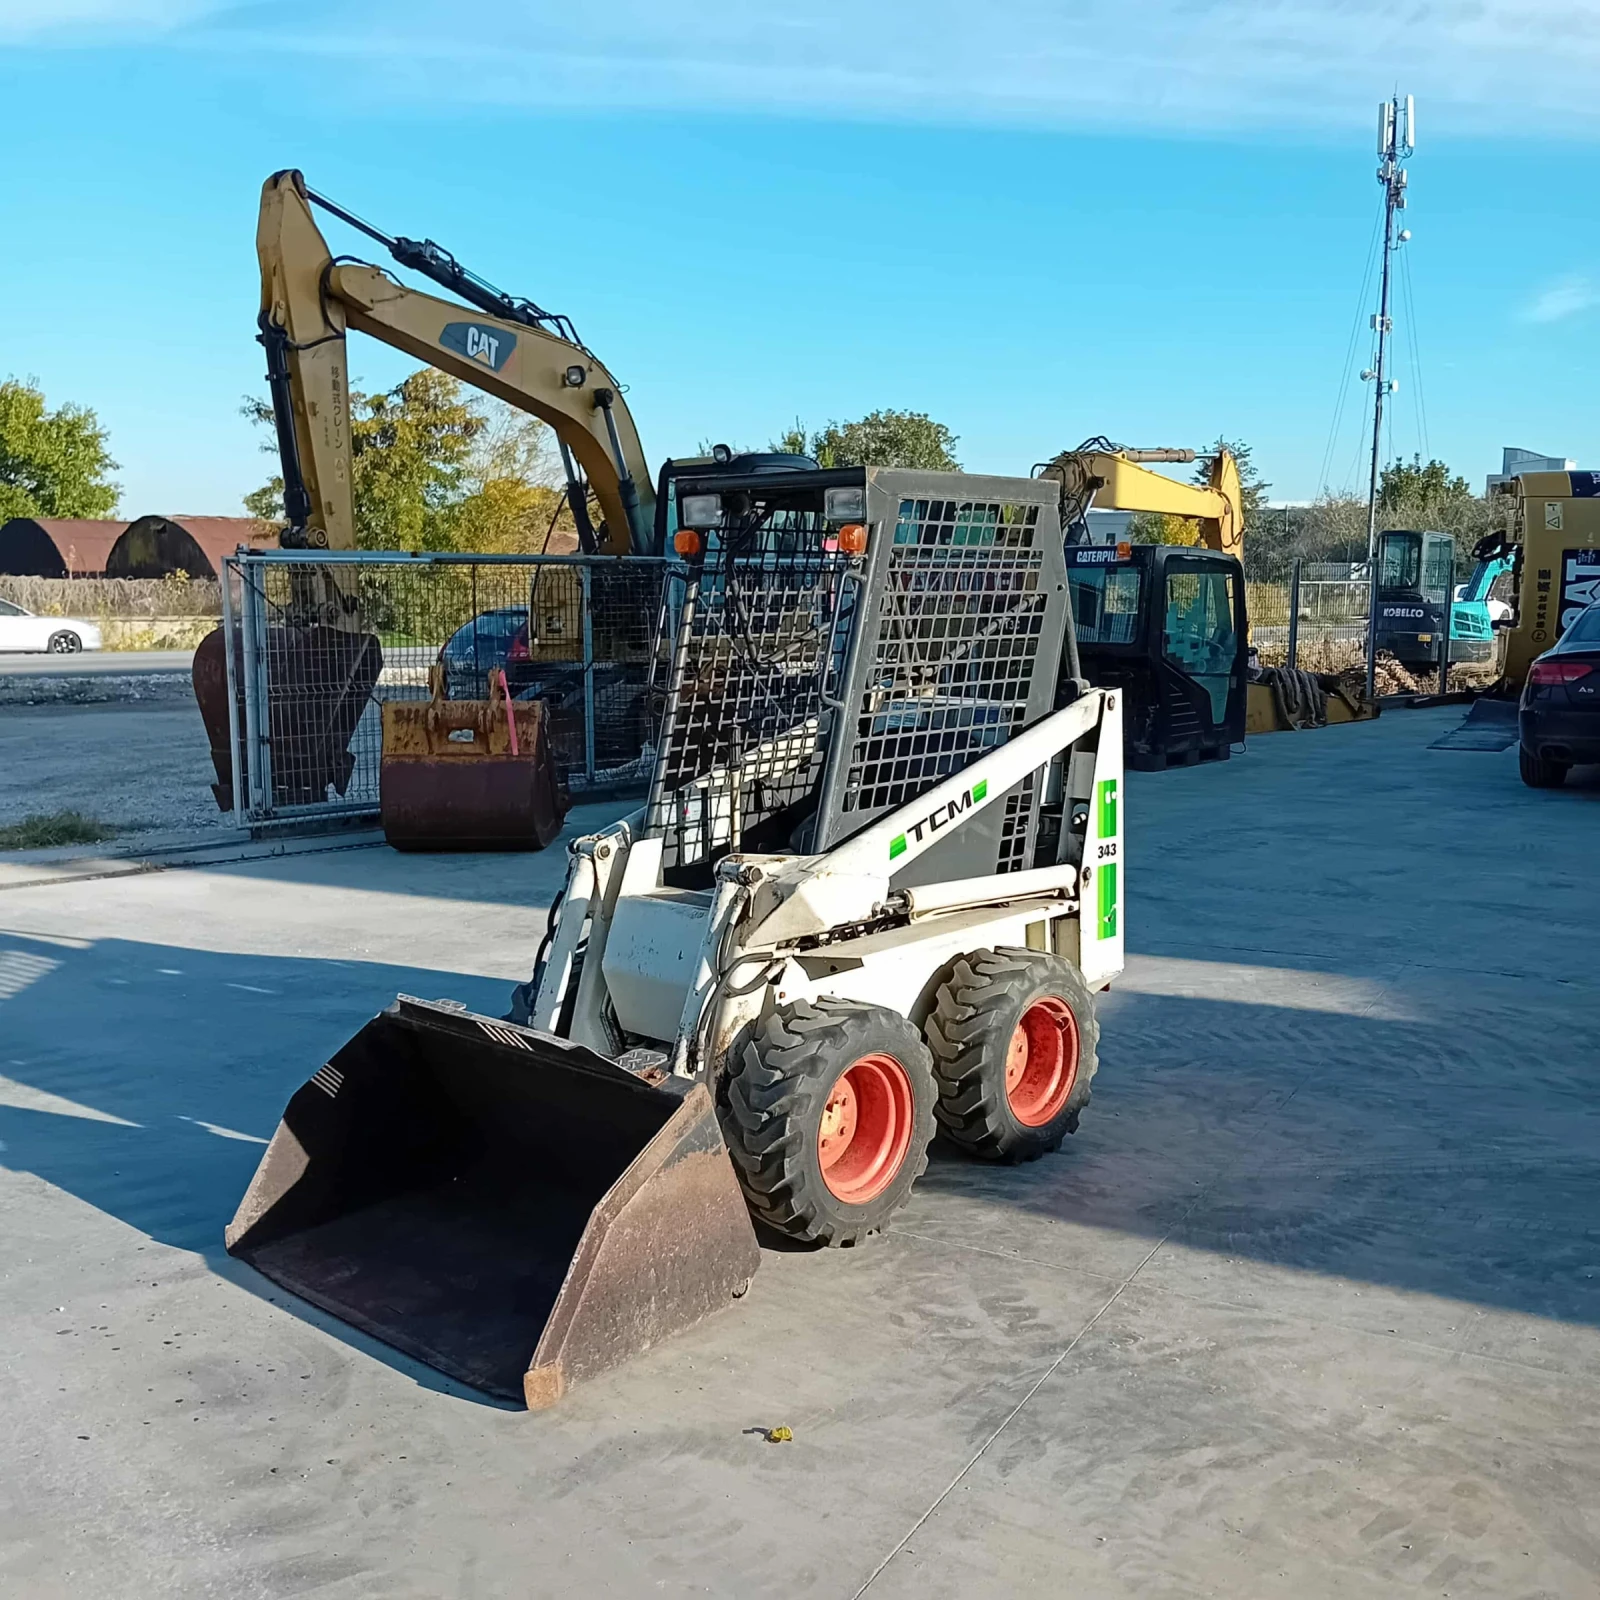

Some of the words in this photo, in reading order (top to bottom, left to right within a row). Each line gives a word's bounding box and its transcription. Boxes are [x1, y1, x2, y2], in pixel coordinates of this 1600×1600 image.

[467, 326, 499, 368] CAT
[1077, 550, 1131, 562] CATERPIL
[1383, 607, 1424, 618] KOBELCO
[906, 790, 972, 842] TCM
[1098, 843, 1117, 859] 343
